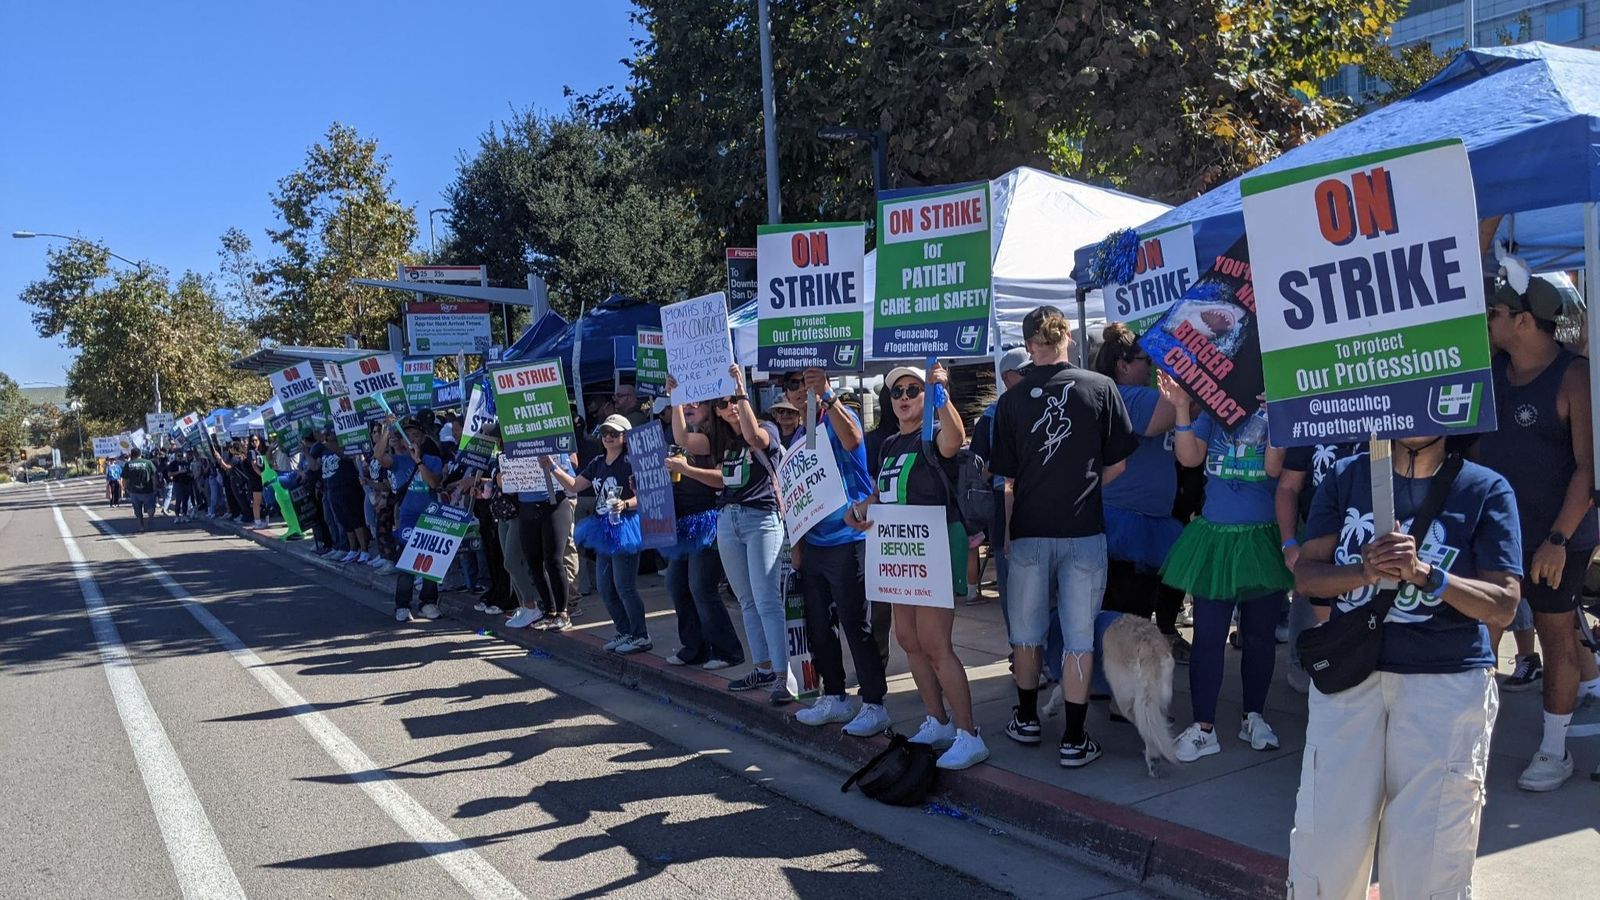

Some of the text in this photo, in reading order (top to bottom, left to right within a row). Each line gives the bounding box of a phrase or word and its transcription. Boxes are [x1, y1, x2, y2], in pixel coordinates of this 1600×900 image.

[890, 198, 981, 235] ON STRIKE
[1315, 167, 1399, 246] ON
[791, 231, 829, 268] ON
[923, 242, 943, 260] for
[1135, 238, 1164, 276] ON
[730, 267, 739, 277] To
[902, 261, 966, 290] PATIENT
[769, 271, 857, 310] STRIKE
[1115, 267, 1191, 316] STRIKE
[1278, 236, 1466, 330] STRIKE
[731, 290, 746, 299] San
[880, 288, 989, 316] CARE and SAFETY
[664, 303, 699, 320] MONTHS
[702, 301, 716, 315] FOR
[666, 321, 690, 341] FAIR
[793, 316, 826, 327] To Protect
[772, 325, 852, 343] Our Professions
[894, 328, 939, 341] @unacuhcp
[669, 338, 729, 362] STILL FASTER
[777, 346, 818, 357] @unacuhcp
[884, 341, 949, 354] #TogetherWeRise
[1175, 319, 1234, 380] BIGGER
[1335, 333, 1405, 359] To Protect
[359, 357, 381, 375] ON
[768, 358, 828, 368] #TogetherWeRise
[1296, 346, 1462, 392] Our Professions
[283, 366, 300, 382] ON
[353, 372, 398, 395] STRIKE
[497, 366, 557, 390] ON STRIKE
[677, 368, 718, 384] CARE AT
[280, 377, 316, 399] STRIKE
[523, 391, 536, 402] for
[685, 378, 723, 400] KAISER!
[1163, 346, 1247, 427] CONTRACT
[513, 401, 554, 420] PATIENT
[1309, 395, 1391, 416] @unacuhcp
[503, 423, 525, 435] CARE
[525, 421, 542, 433] and
[542, 415, 571, 429] SAFETY
[1292, 415, 1414, 439] #TogetherWeRise
[638, 452, 660, 472] YOUR
[792, 454, 818, 480] LIVES
[785, 467, 826, 514] LISTEN FOR
[792, 490, 814, 517] ONCE
[877, 523, 930, 539] PATIENTS
[410, 531, 454, 556] STRIKE
[880, 541, 926, 557] BEFORE
[412, 552, 434, 573] ON
[879, 563, 928, 578] PROFITS
